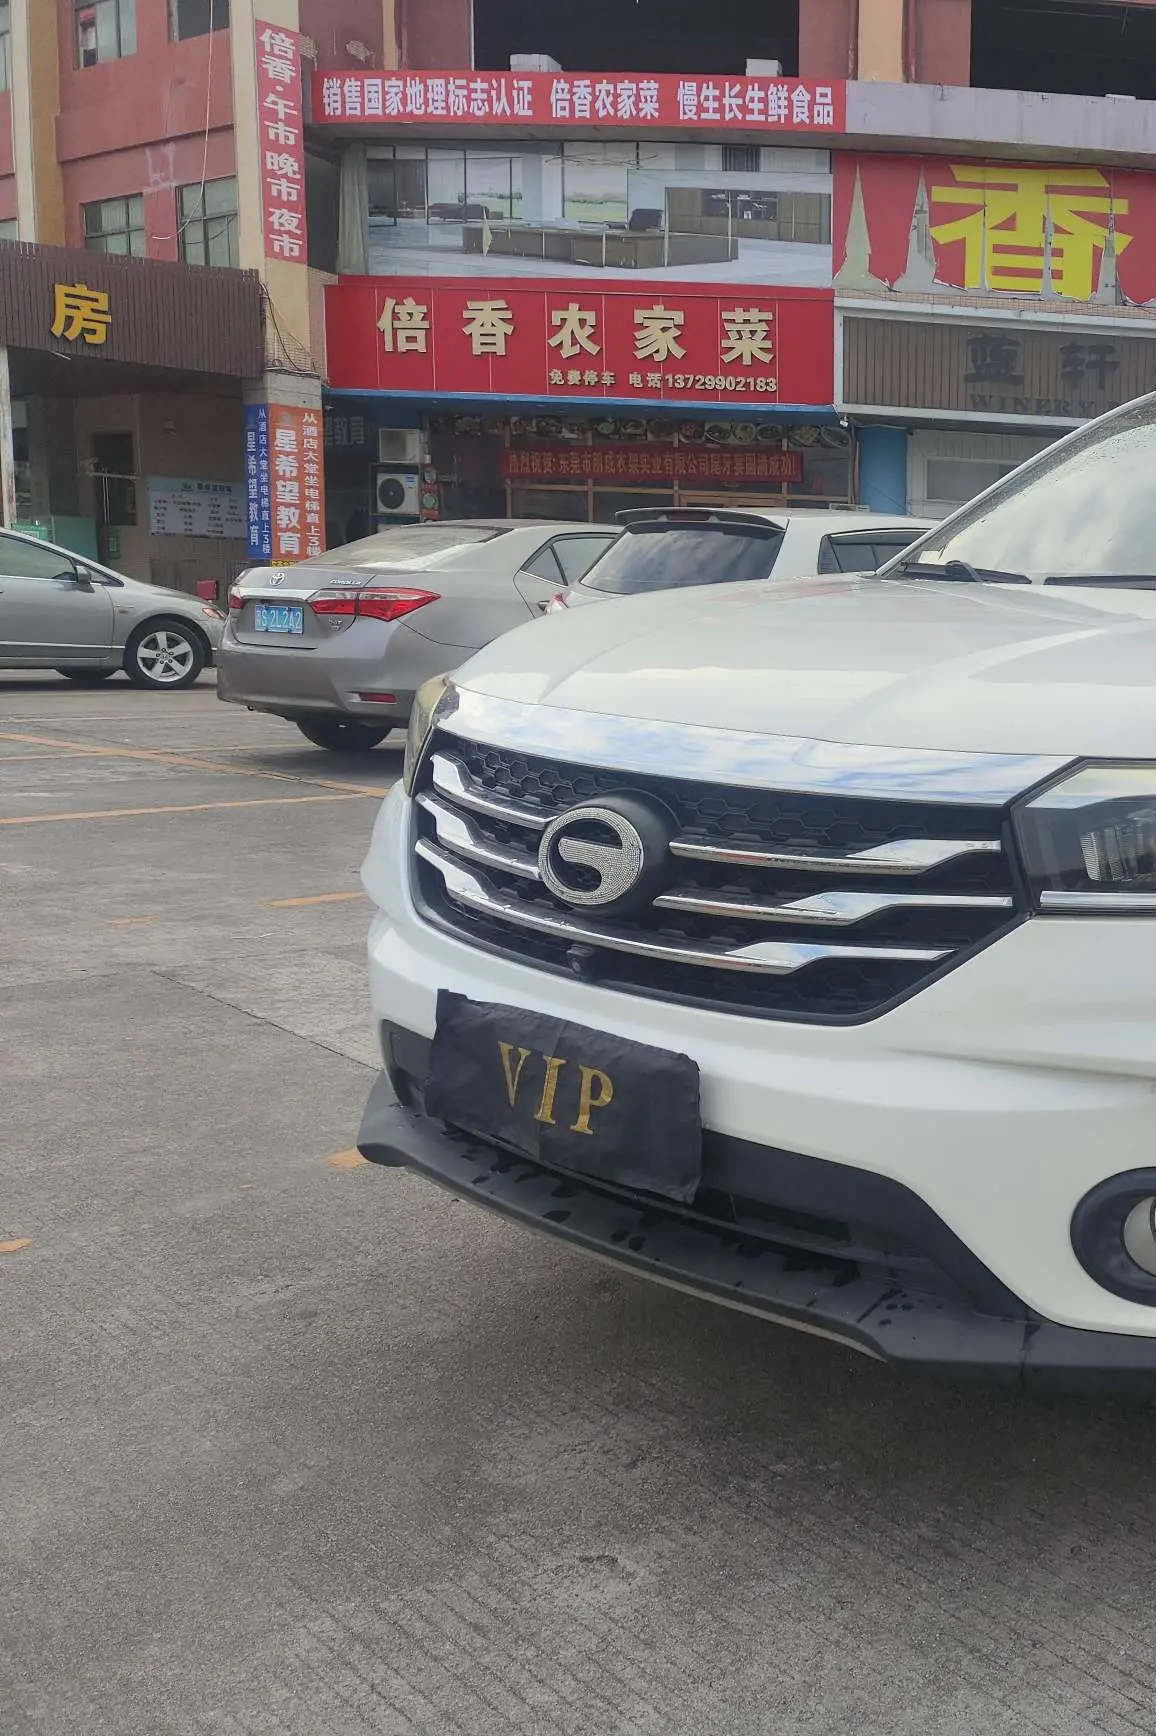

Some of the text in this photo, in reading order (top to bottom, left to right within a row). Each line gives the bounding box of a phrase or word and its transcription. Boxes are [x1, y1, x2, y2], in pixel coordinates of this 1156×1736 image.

[322, 77, 834, 125] 销售国家地理标志认证 倍香农家菜 慢生长生鲜食品
[50, 283, 112, 345] 房
[376, 296, 775, 365] 倍香农家菜
[548, 369, 616, 386] 免费停车
[247, 431, 259, 546] 星希望教育
[274, 429, 301, 555] 星希望教育
[302, 412, 322, 557] 从酒店大堂坐电梯直上3楼
[498, 1041, 614, 1135] VIP
